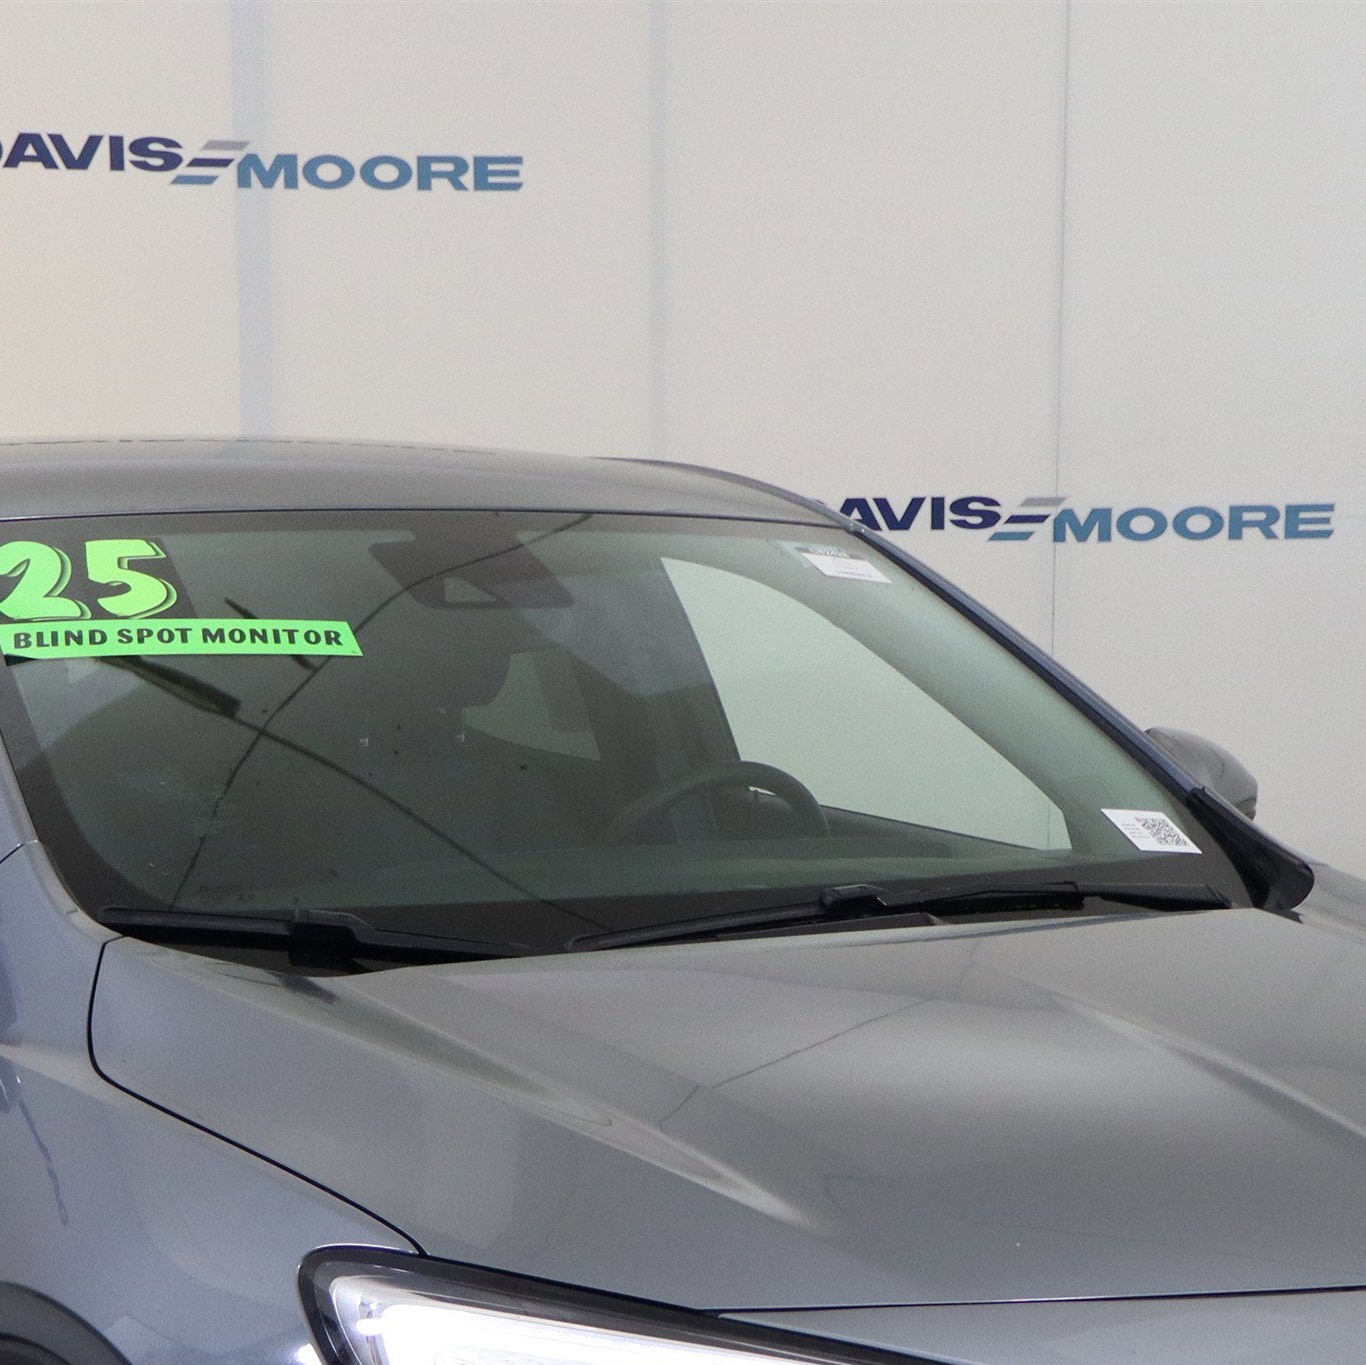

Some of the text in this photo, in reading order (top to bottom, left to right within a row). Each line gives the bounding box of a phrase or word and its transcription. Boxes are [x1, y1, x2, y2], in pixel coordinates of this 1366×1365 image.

[237, 153, 523, 192] MOORE
[1053, 503, 1335, 542] MOORE
[13, 627, 344, 649] BLIND SPOT MONITOR
